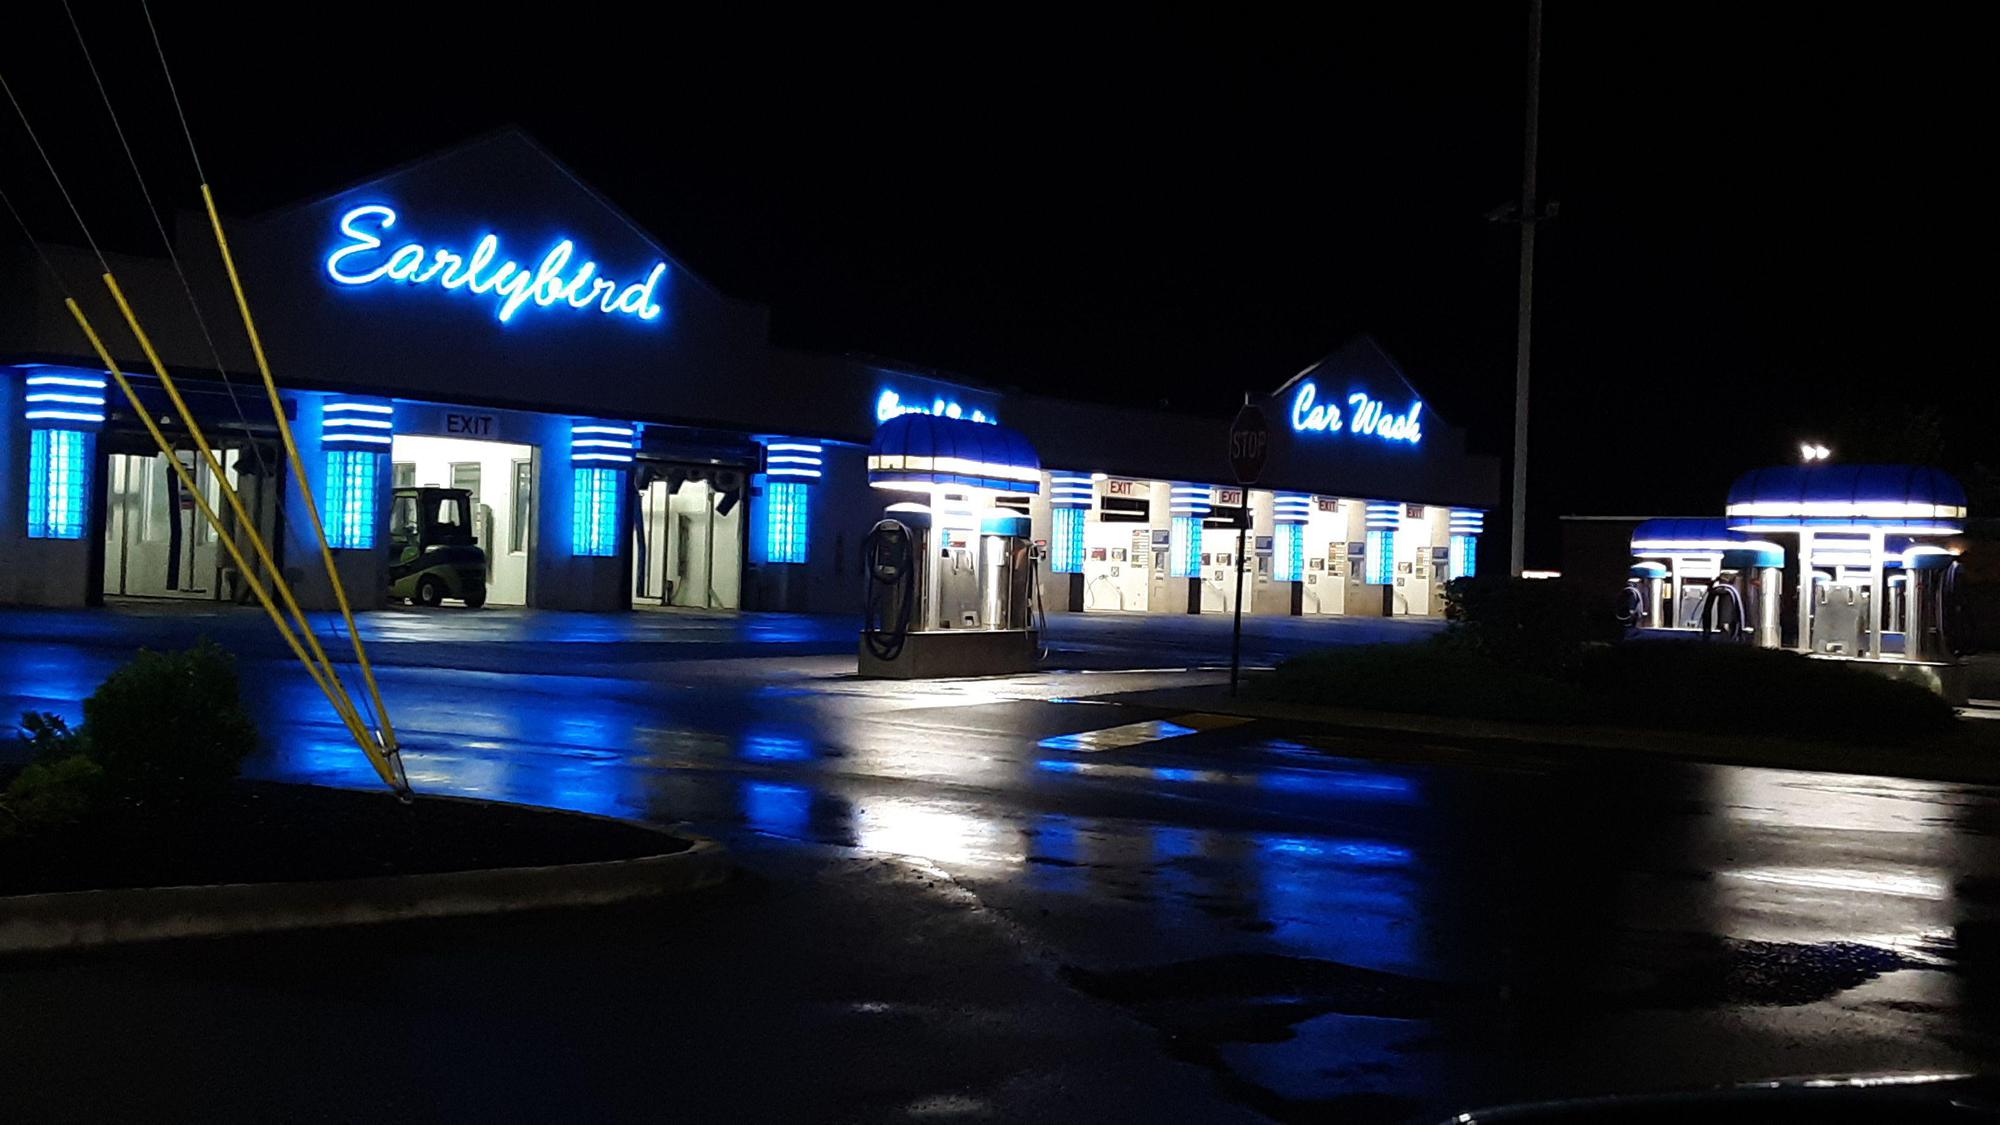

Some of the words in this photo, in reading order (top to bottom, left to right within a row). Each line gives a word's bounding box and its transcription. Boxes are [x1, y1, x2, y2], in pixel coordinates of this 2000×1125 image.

[327, 205, 666, 322] Earlybird
[1292, 382, 1343, 431] Car
[1348, 392, 1423, 444] Wash
[447, 414, 492, 435] EXIT
[1232, 431, 1267, 459] STOP
[1109, 480, 1133, 495] EXIT
[1221, 490, 1242, 504] EXIT
[1318, 501, 1336, 513] EXIT
